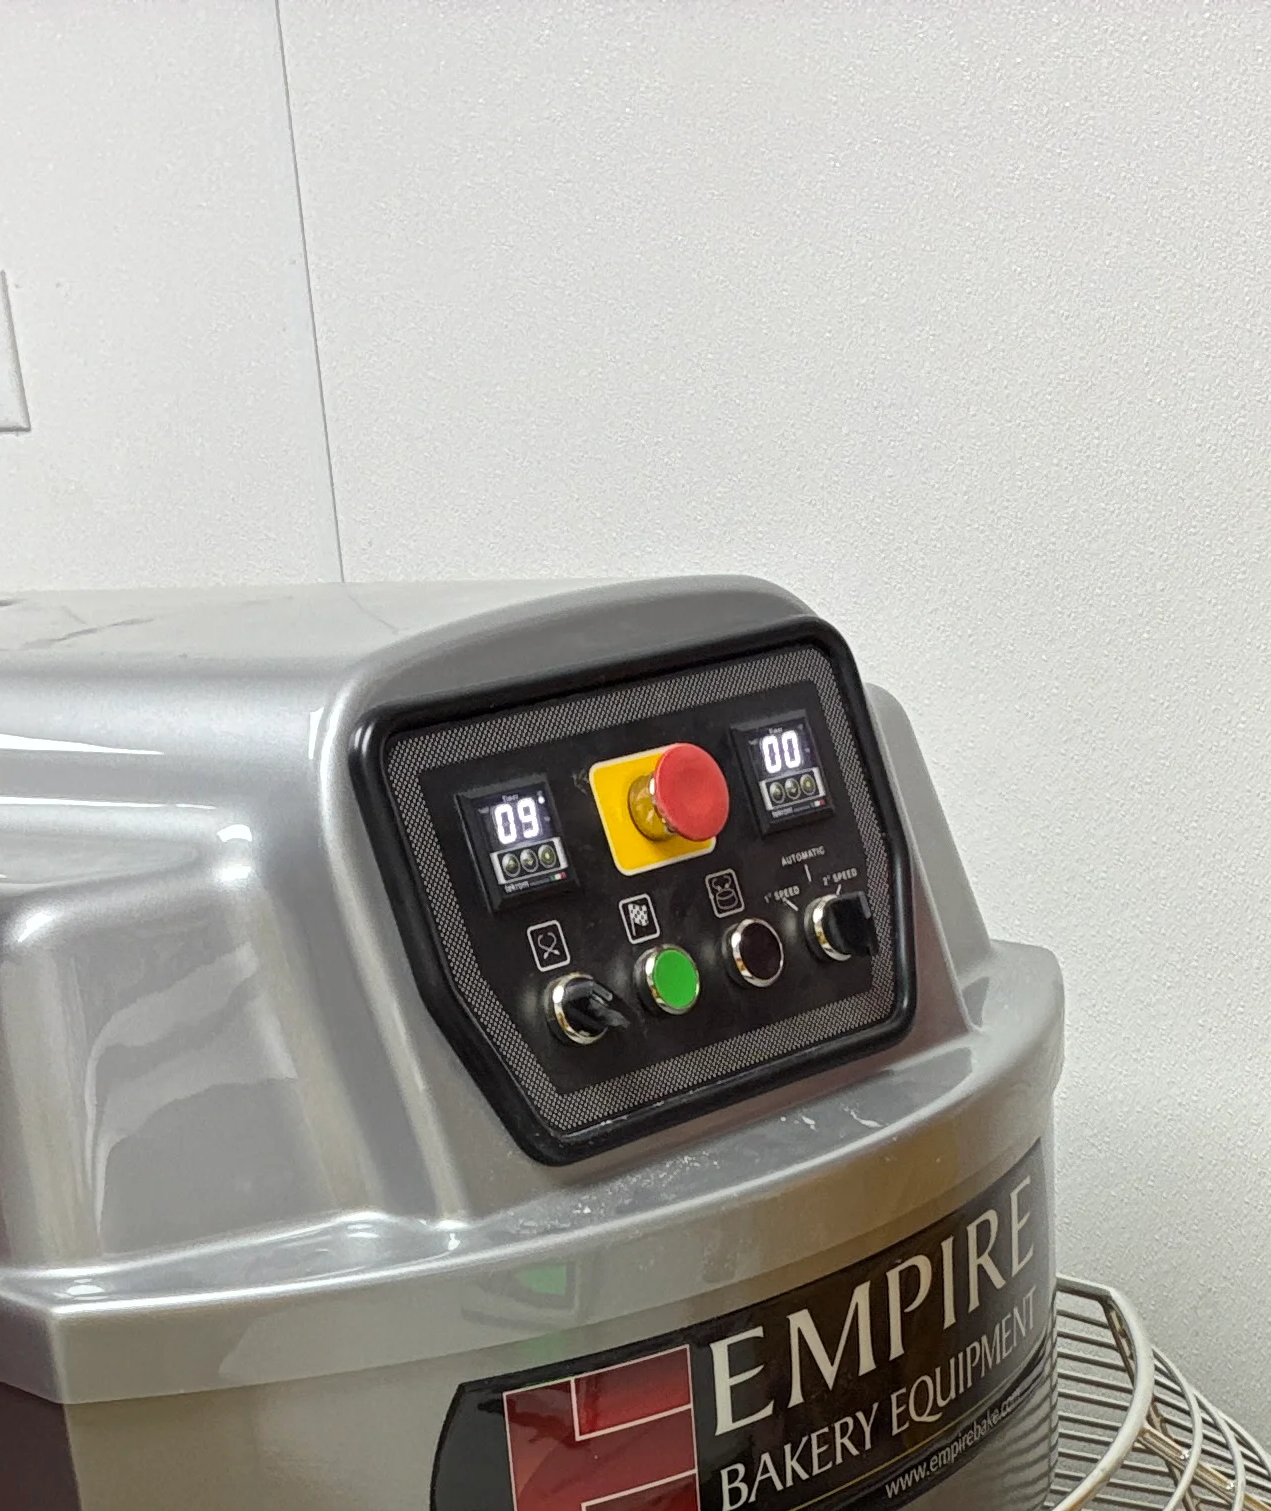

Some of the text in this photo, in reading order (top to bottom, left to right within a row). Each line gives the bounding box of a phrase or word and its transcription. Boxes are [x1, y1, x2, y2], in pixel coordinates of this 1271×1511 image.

[762, 730, 801, 774] 00
[494, 797, 540, 845] 09
[781, 845, 826, 867] AUTOMATIC
[832, 867, 858, 883] SPEED
[773, 885, 800, 901] SPEED
[709, 1176, 1034, 1437] EMPIRE
[890, 1284, 1037, 1437] EQUIPMENT
